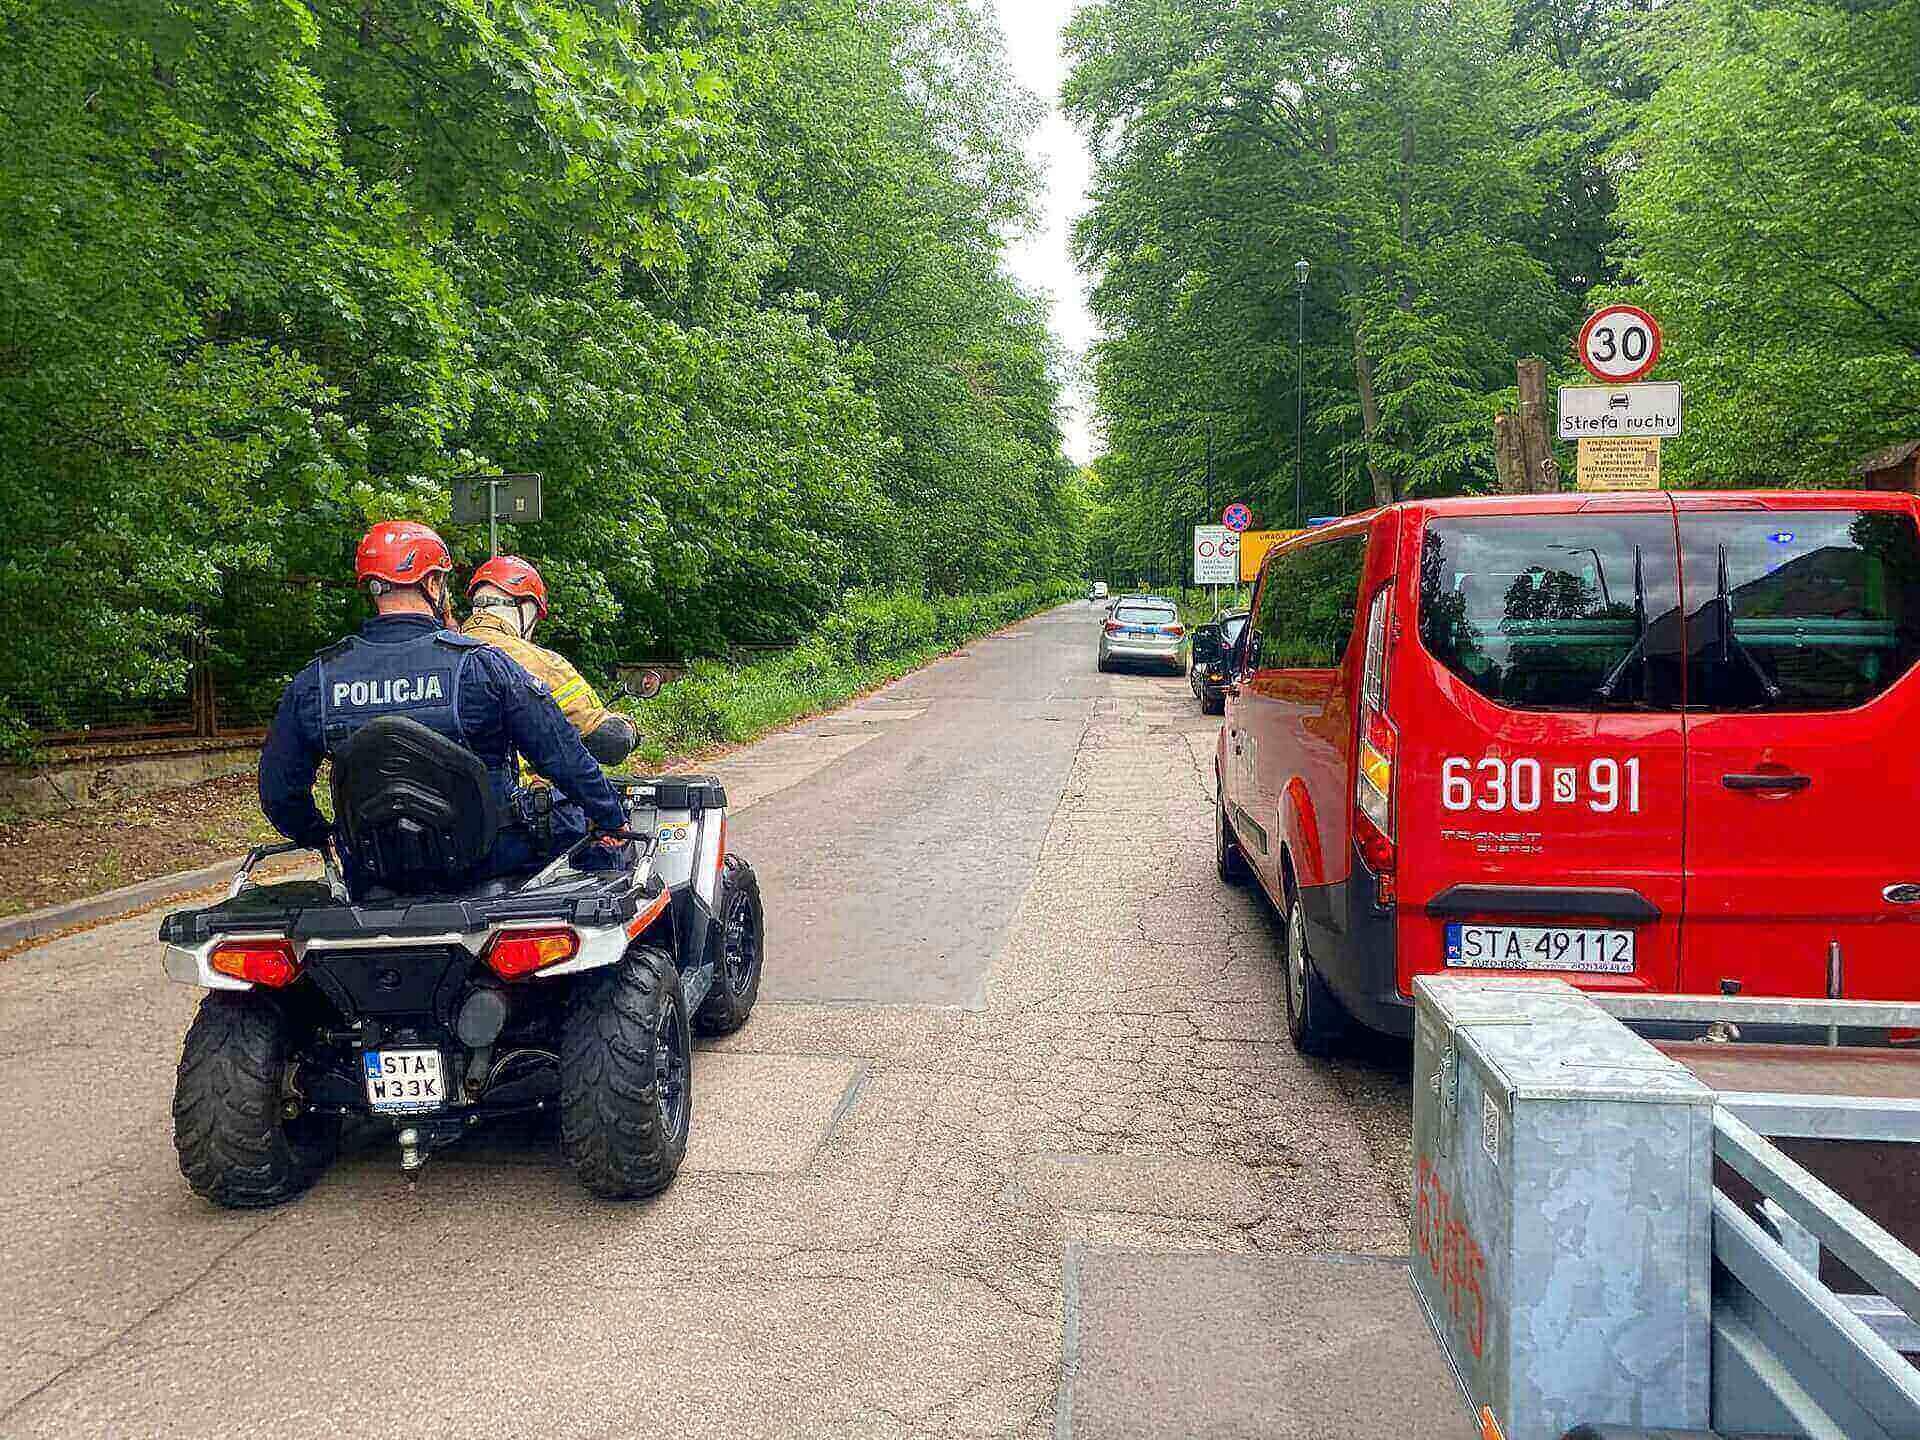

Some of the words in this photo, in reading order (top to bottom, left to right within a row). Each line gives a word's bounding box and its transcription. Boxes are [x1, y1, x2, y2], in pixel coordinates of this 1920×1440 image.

[1592, 326, 1647, 363] 30
[1564, 414, 1618, 431] Strefa
[1627, 413, 1676, 429] ruchu
[333, 675, 443, 707] POLICJA
[1442, 757, 1541, 811] 630
[1557, 772, 1574, 798] S
[1588, 757, 1640, 812] 91
[1440, 829, 1542, 842] TRANSIT
[1465, 930, 1522, 959] STA
[1534, 932, 1630, 962] 49112
[384, 1055, 426, 1074] STA
[373, 1079, 437, 1098] W33K
